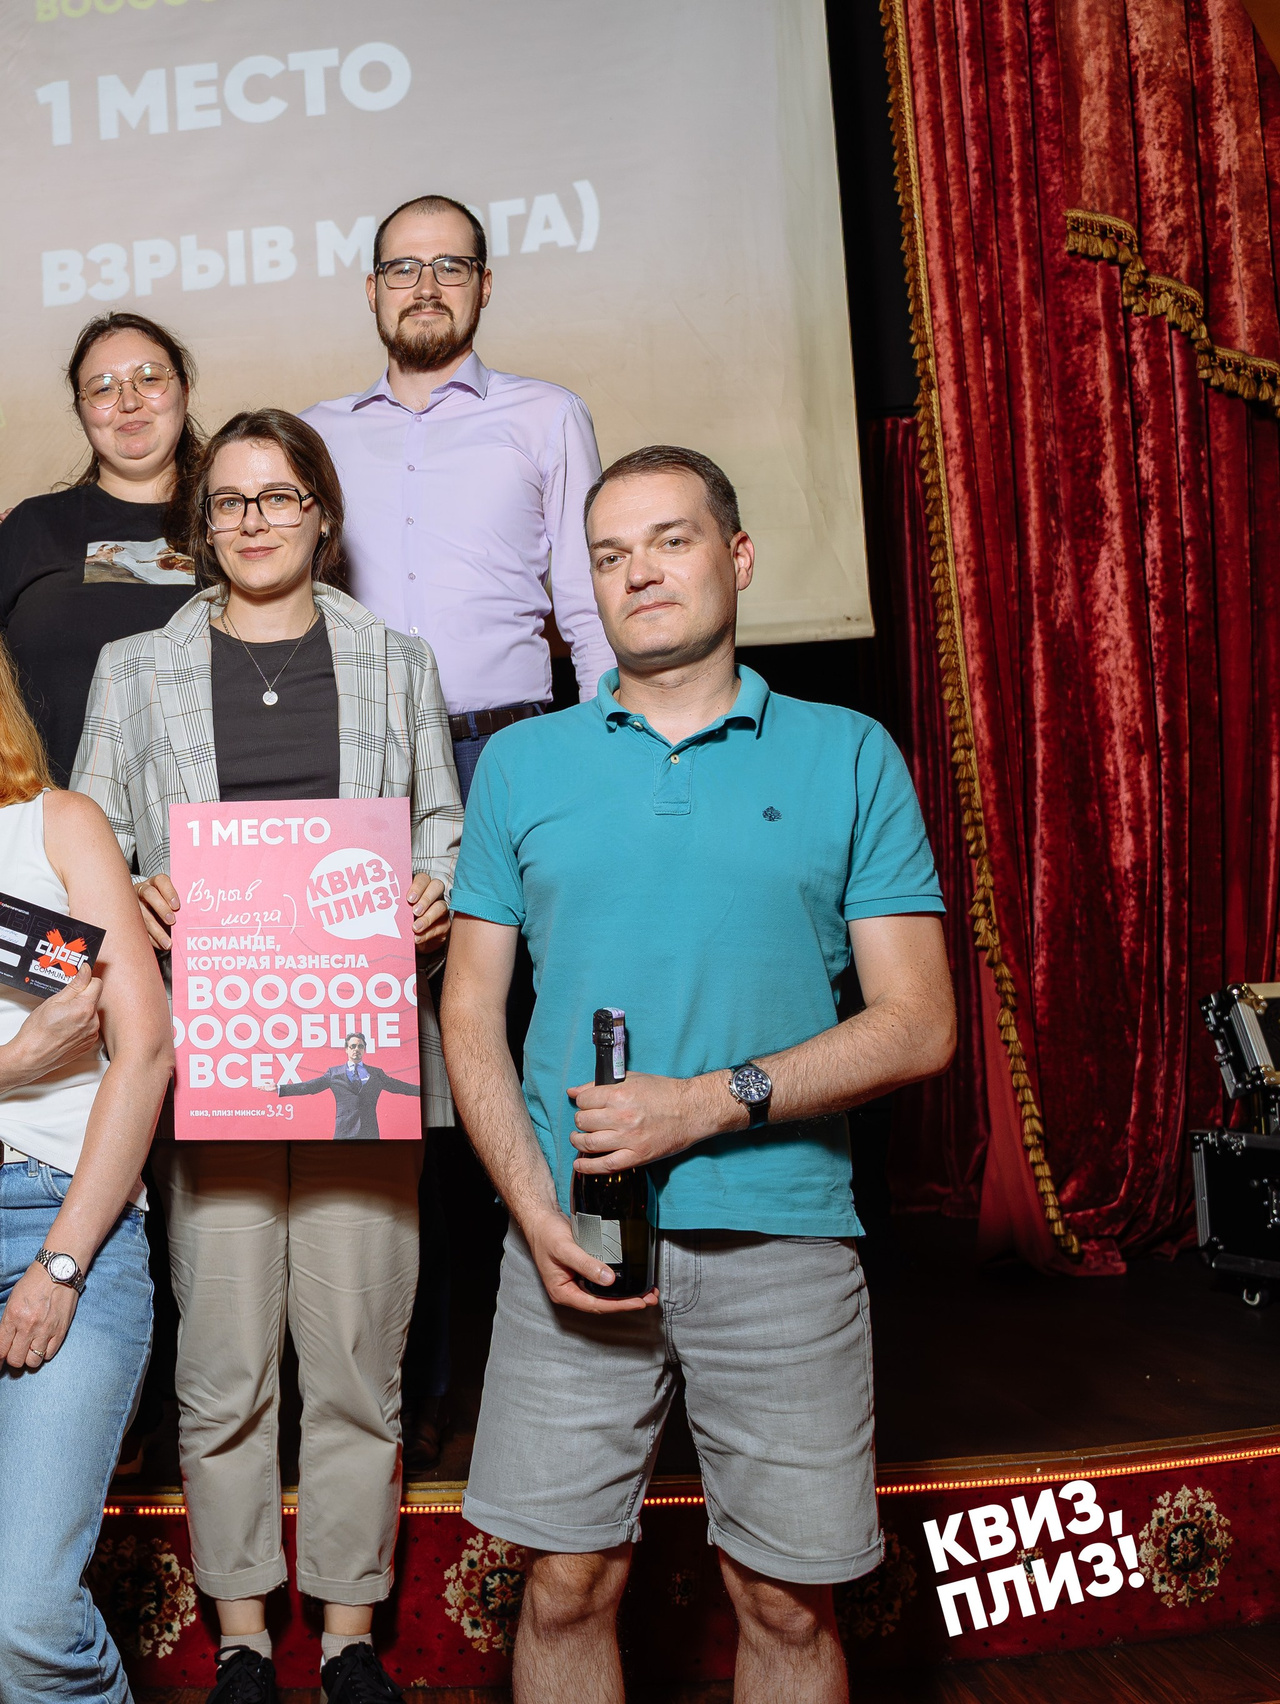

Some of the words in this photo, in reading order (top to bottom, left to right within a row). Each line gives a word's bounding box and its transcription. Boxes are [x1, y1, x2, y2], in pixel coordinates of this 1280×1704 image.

[35, 80, 72, 147] 1
[98, 42, 412, 141] МЕСТО
[41, 225, 299, 308] ВЗРЫВ
[315, 180, 601, 278] МГА)
[187, 820, 200, 847] 1
[212, 816, 331, 847] МЕСТО
[186, 878, 262, 913] Взрыв
[309, 858, 398, 902] КВИЗ,
[311, 883, 401, 928] ПЛИЗ!
[186, 935, 281, 952] КОМАНДЕ,
[187, 955, 270, 971] КОТОРАЯ
[275, 954, 369, 969] РАЗНЕСЛА
[189, 1052, 304, 1088] ВСЕХ
[190, 1109, 211, 1118] КВИЗ,
[212, 1109, 234, 1117] ПЛИЗ!
